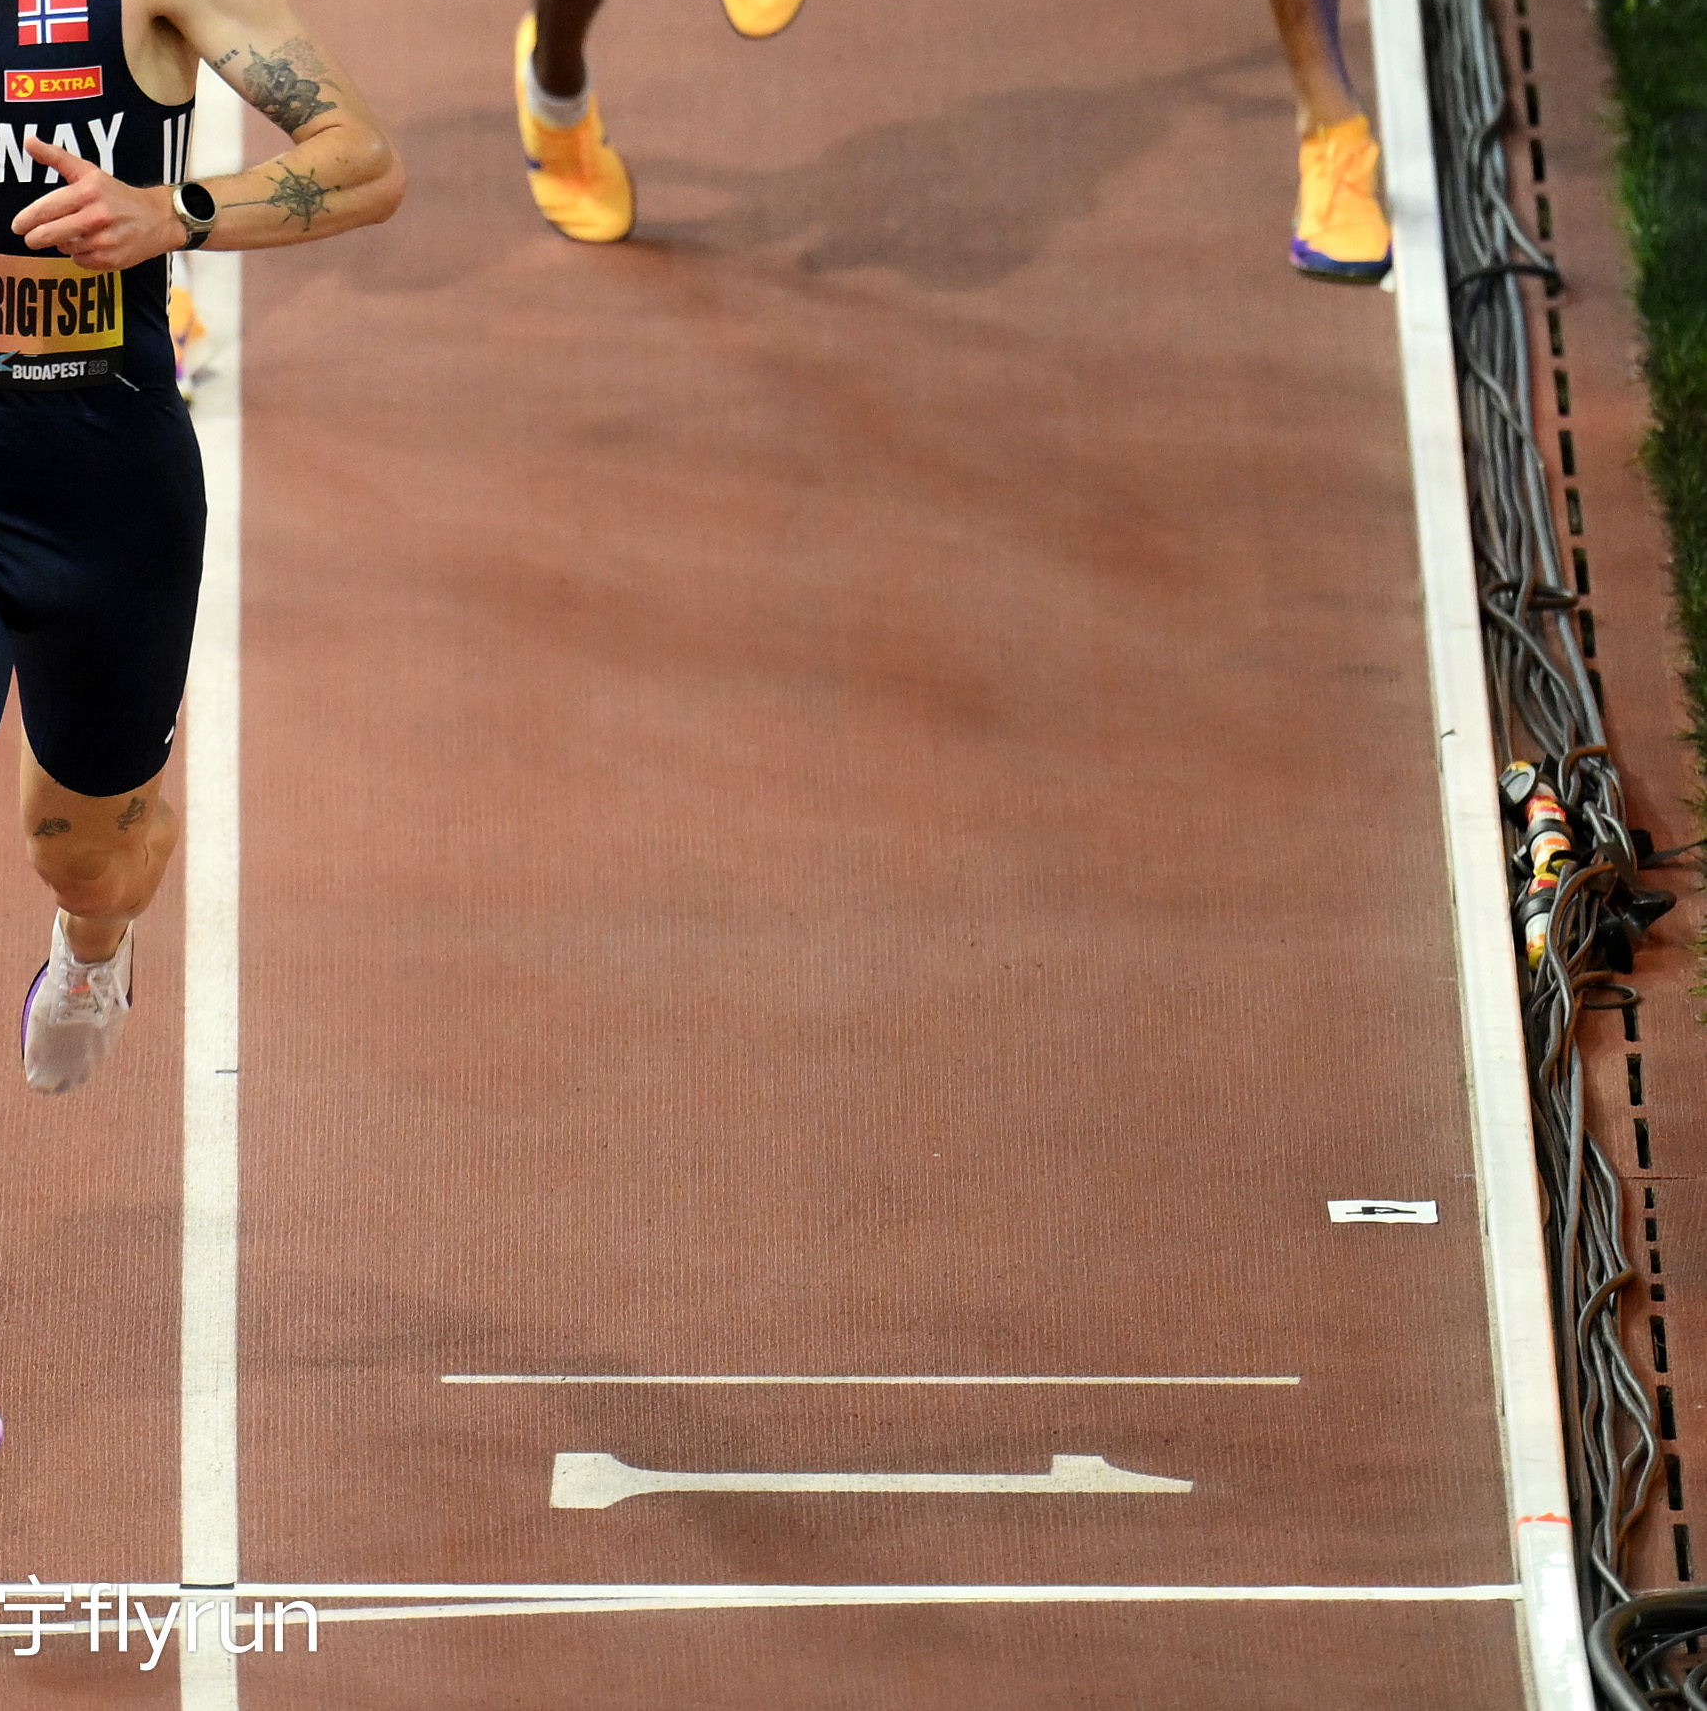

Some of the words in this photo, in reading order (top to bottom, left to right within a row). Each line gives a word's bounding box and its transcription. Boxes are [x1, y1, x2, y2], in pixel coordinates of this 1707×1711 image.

[40, 76, 96, 92] EXTRA
[12, 361, 87, 381] BUDAPEST
[88, 359, 109, 376] 26
[550, 1452, 1195, 1511] 1
